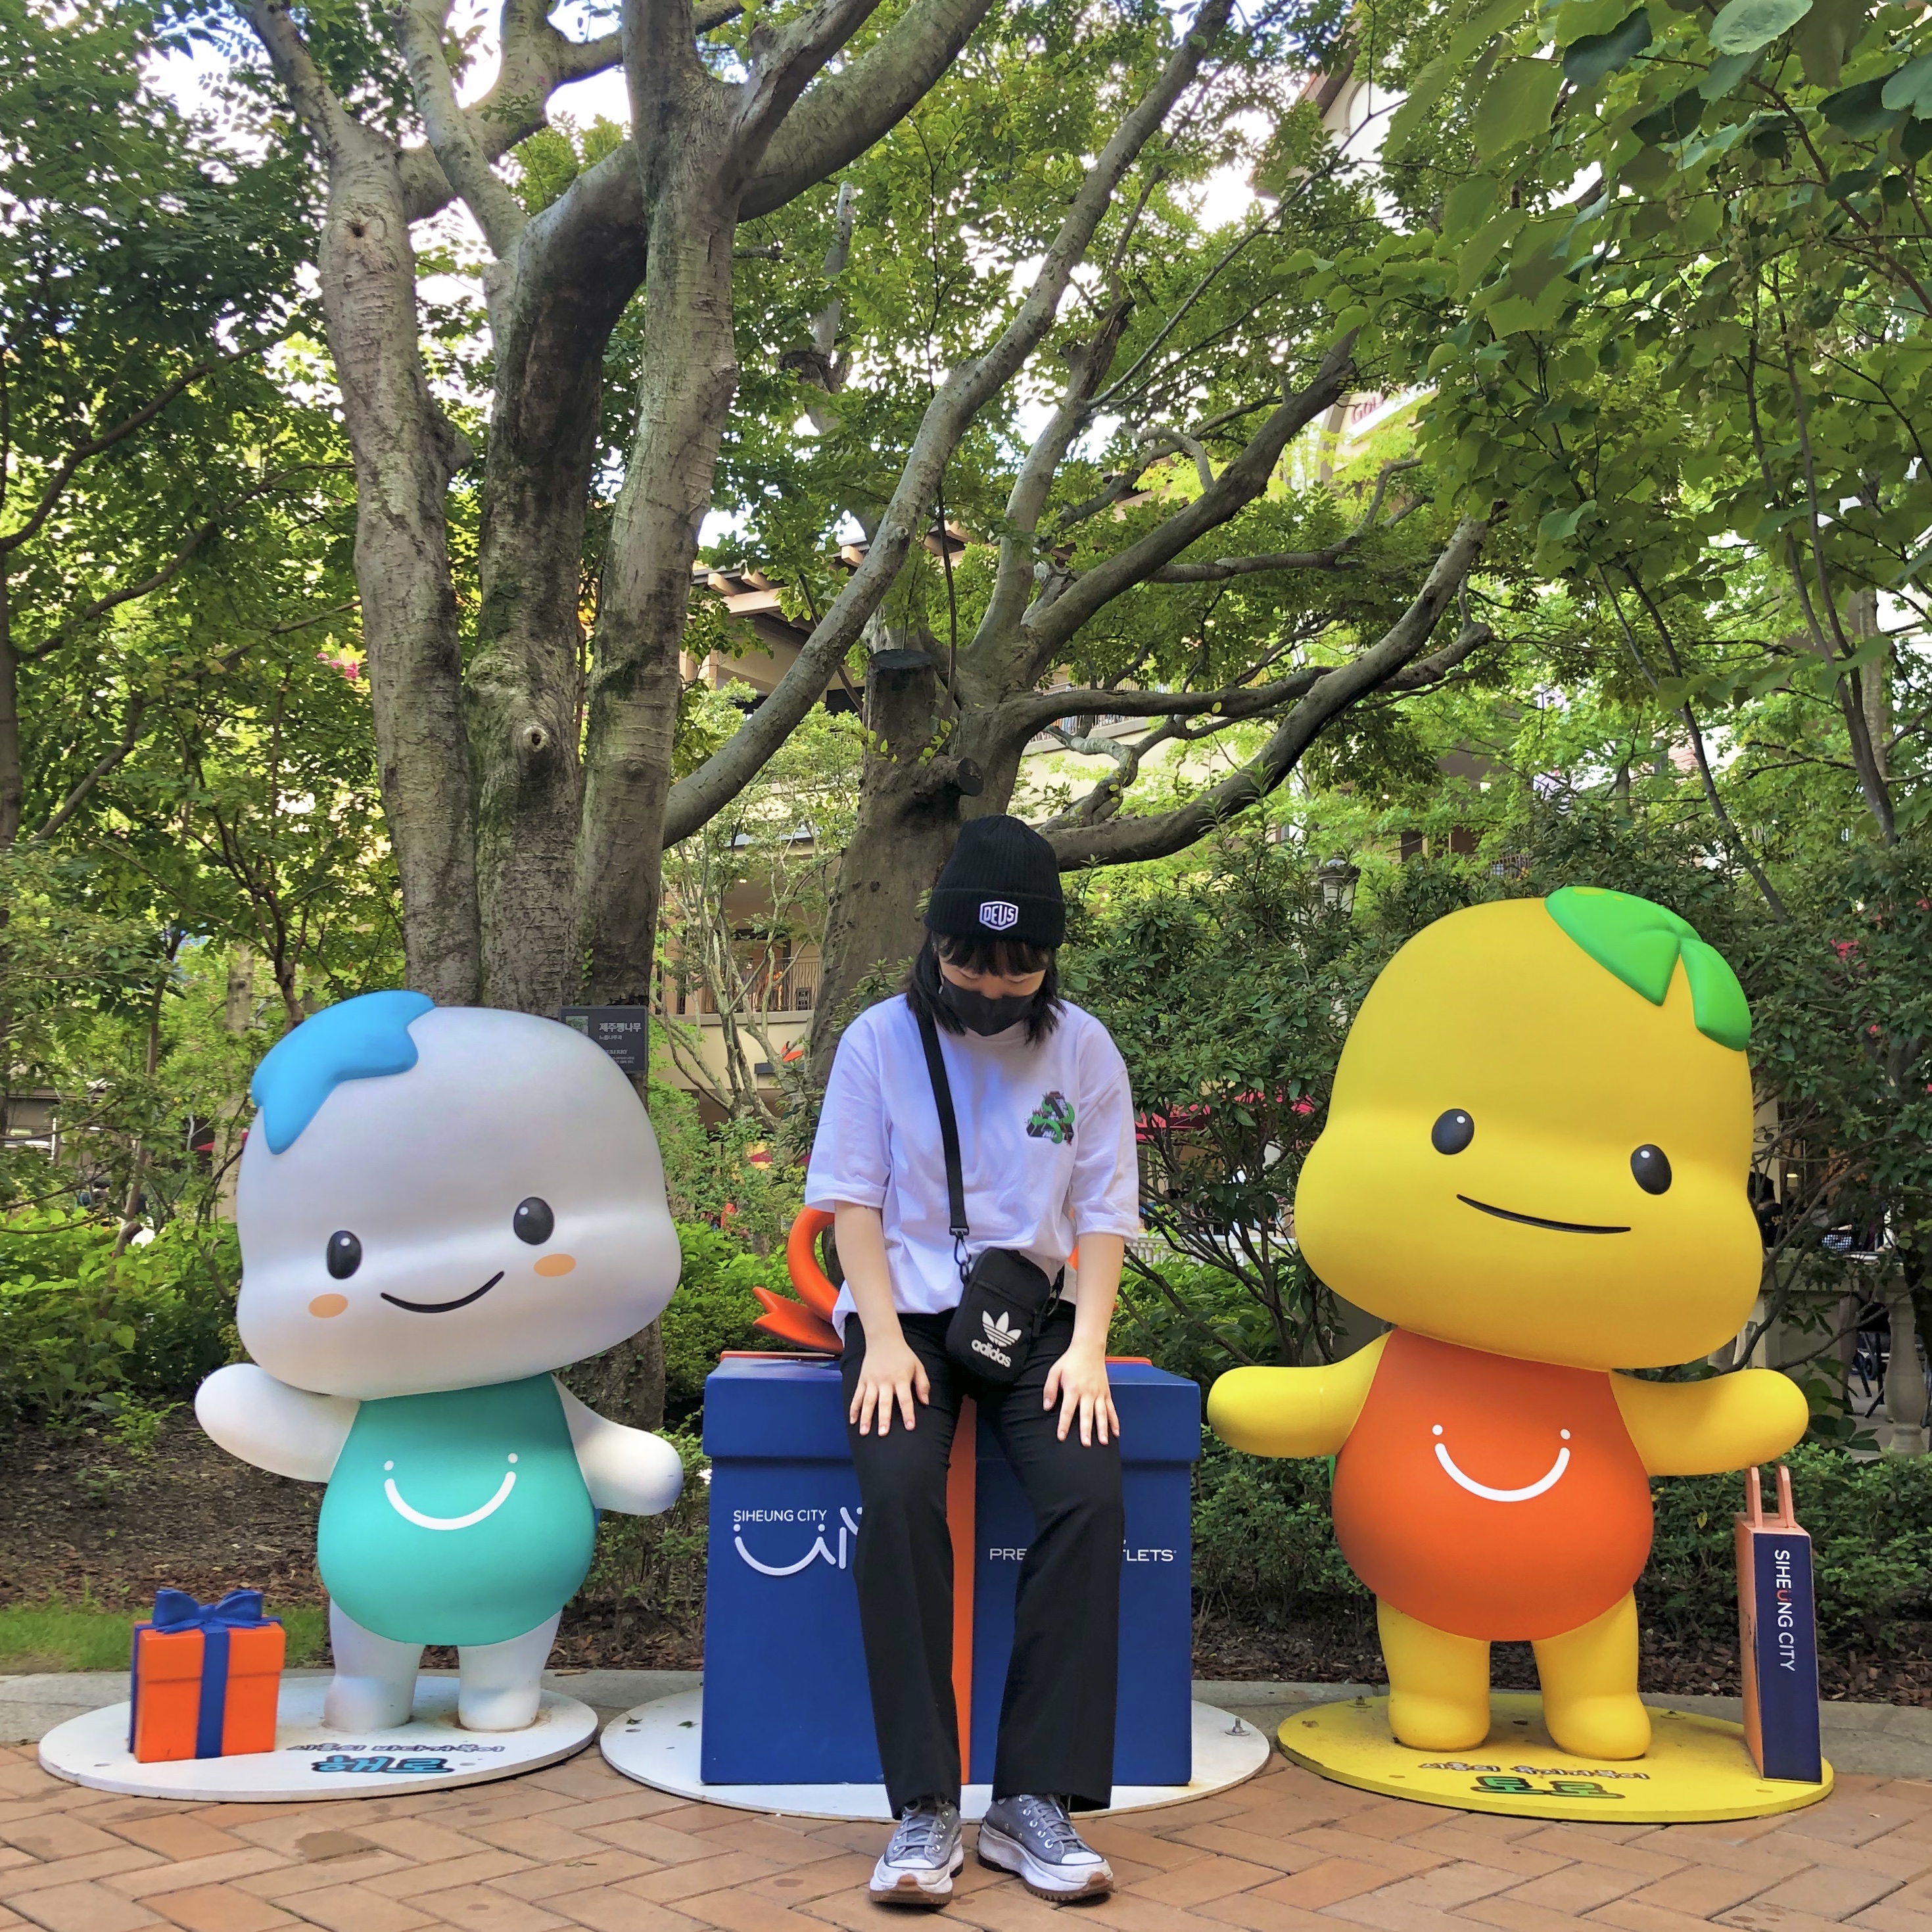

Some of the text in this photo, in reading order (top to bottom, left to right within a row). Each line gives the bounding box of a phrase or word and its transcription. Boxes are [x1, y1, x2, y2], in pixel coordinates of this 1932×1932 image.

[983, 905, 1015, 926] DEUS
[972, 1339, 1012, 1367] adidas
[733, 1509, 827, 1522] SIHEUNG CITY
[1123, 1549, 1173, 1562] LETS
[1774, 1549, 1795, 1672] SIHEUNG CITY
[286, 1743, 506, 1753] 시흥의 바다거북이
[311, 1755, 455, 1773] 해로
[1418, 1762, 1501, 1772] 시흥의
[1471, 1776, 1626, 1799] 토로
